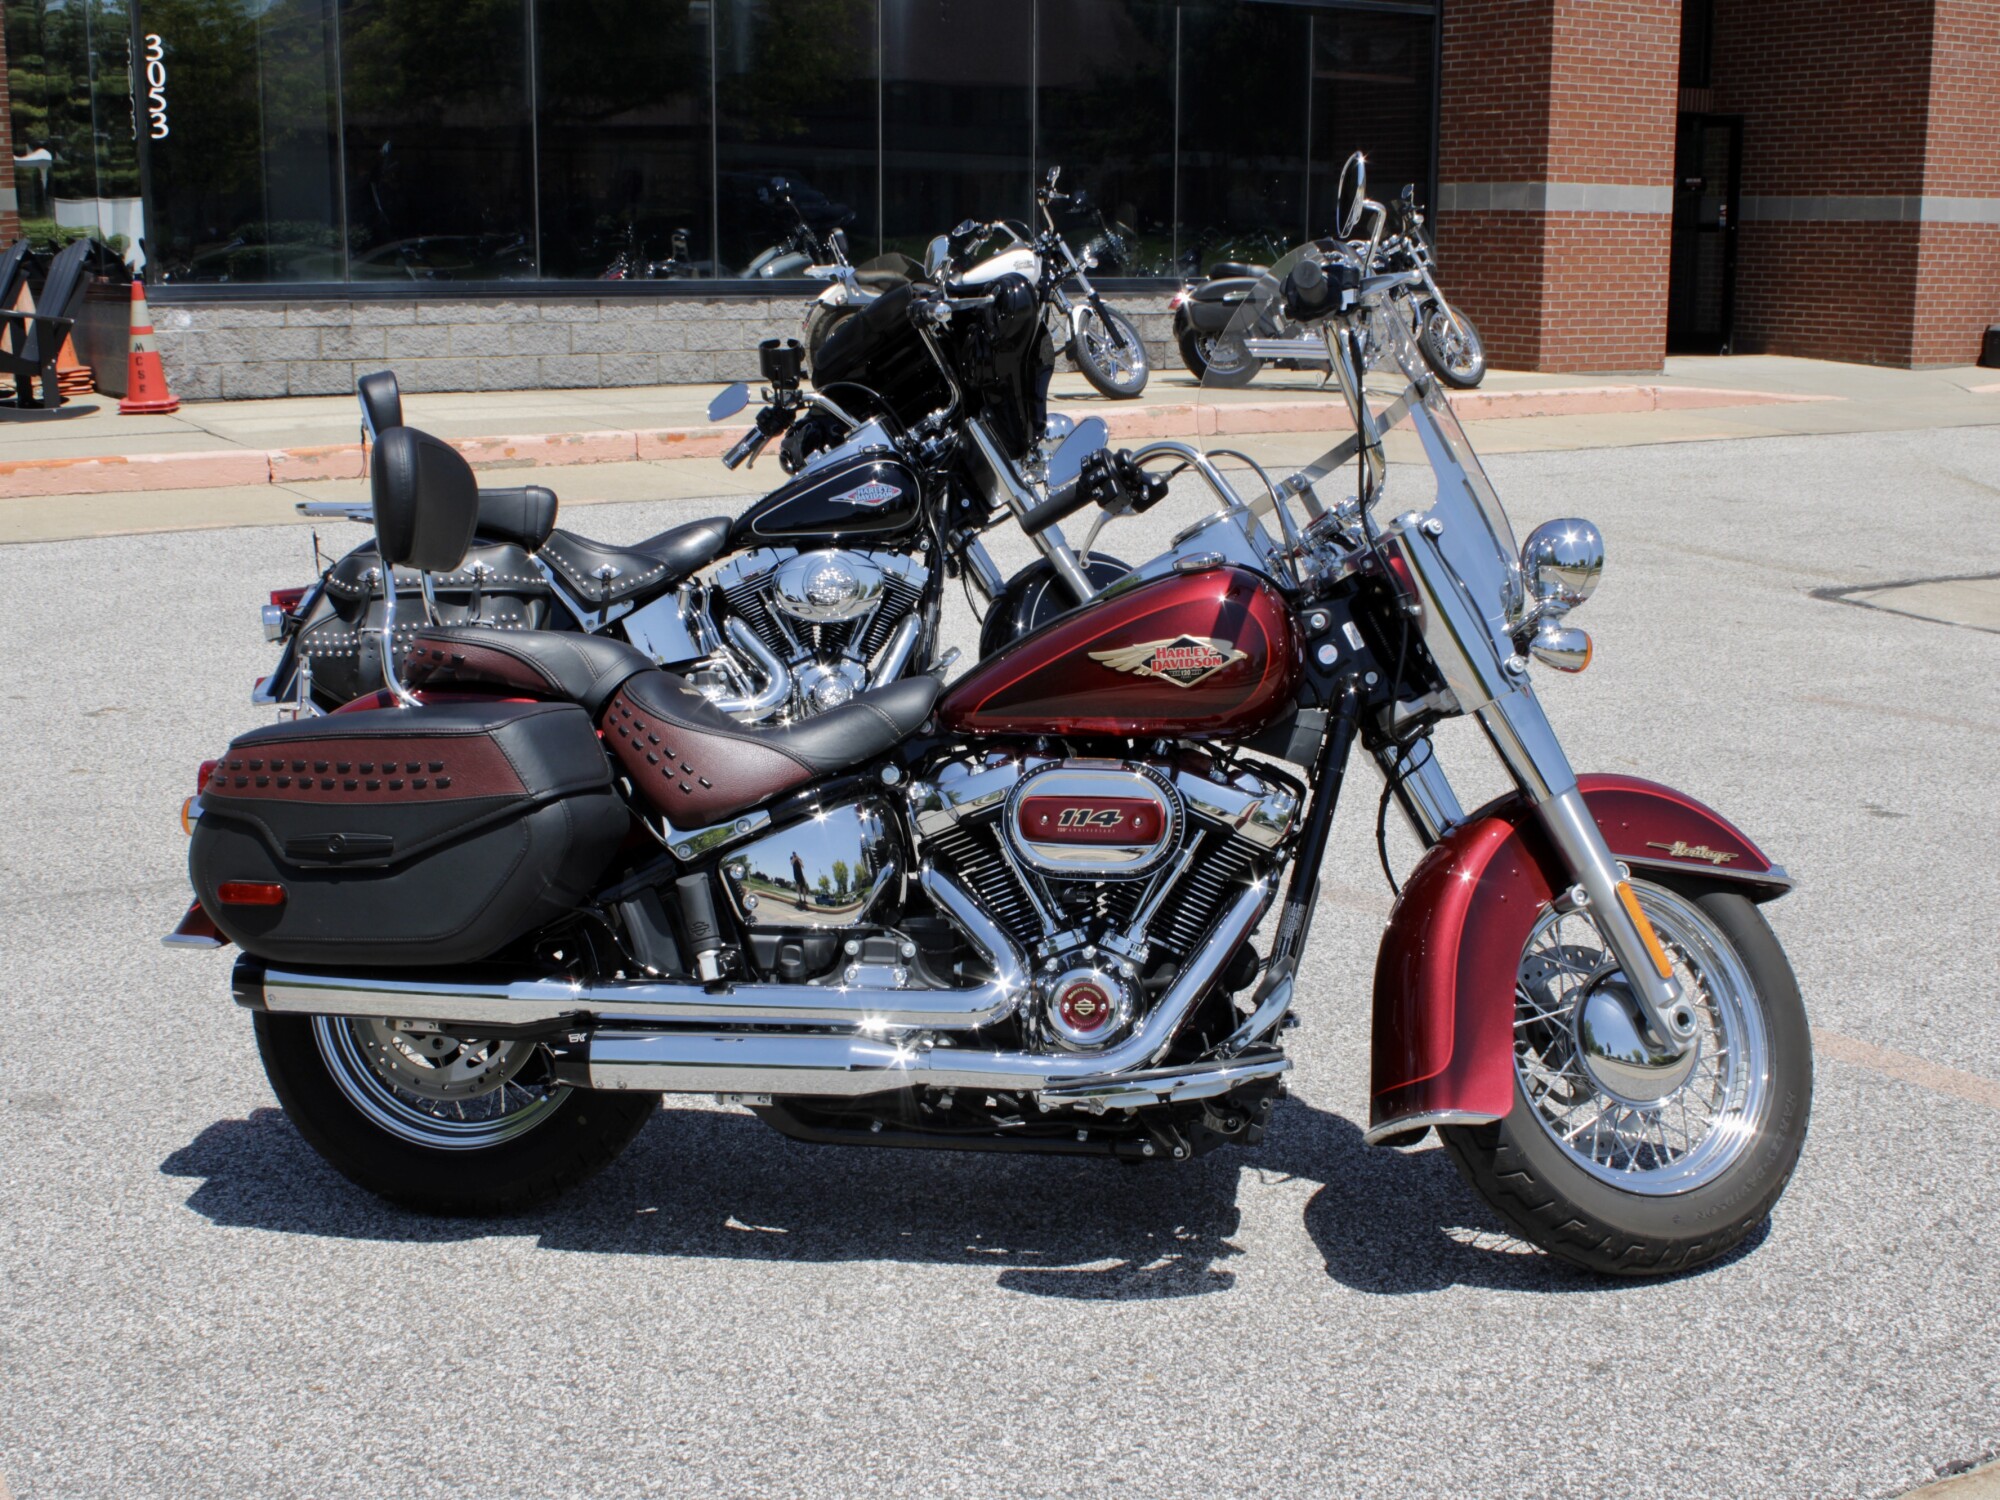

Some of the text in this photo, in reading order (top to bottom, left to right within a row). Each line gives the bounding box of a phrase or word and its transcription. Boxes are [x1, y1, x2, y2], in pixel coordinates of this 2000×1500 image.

[144, 33, 170, 139] 3053
[855, 492, 893, 501] DAVIDSON
[1151, 656, 1222, 673] DAVIDSON
[1057, 808, 1124, 828] 114
[1669, 841, 1739, 865] Heritage
